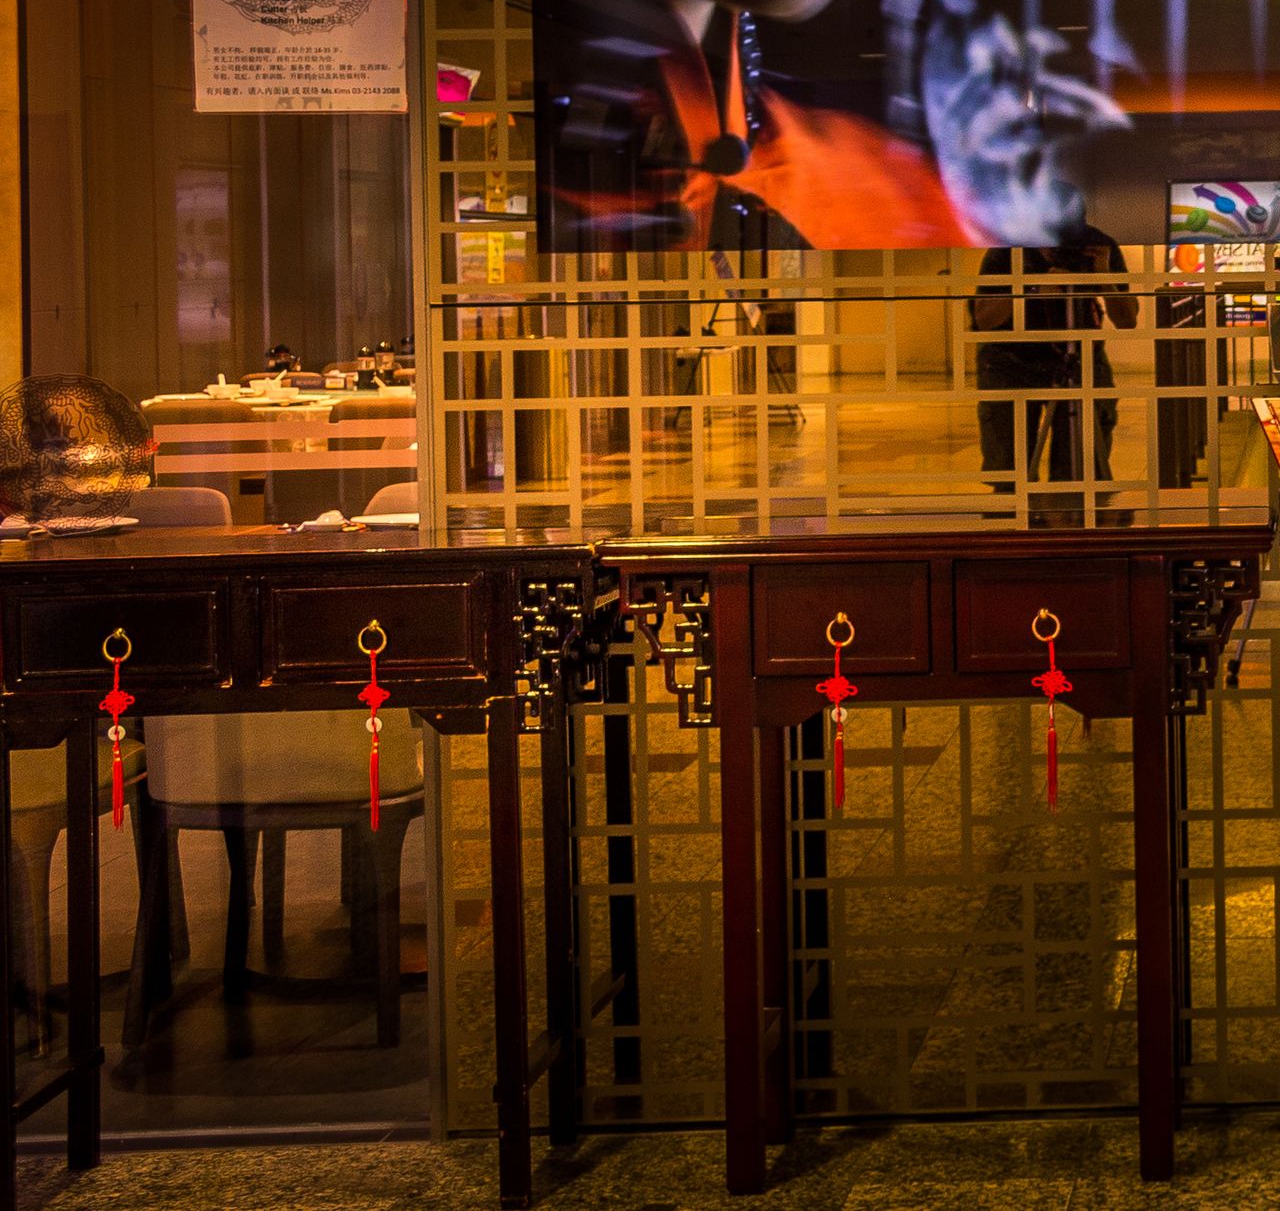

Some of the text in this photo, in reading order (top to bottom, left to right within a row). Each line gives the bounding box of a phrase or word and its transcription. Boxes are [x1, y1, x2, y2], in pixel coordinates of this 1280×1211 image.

[260, 5, 288, 14] Cutter
[260, 16, 295, 25] Kitchen
[297, 16, 325, 27] Helper
